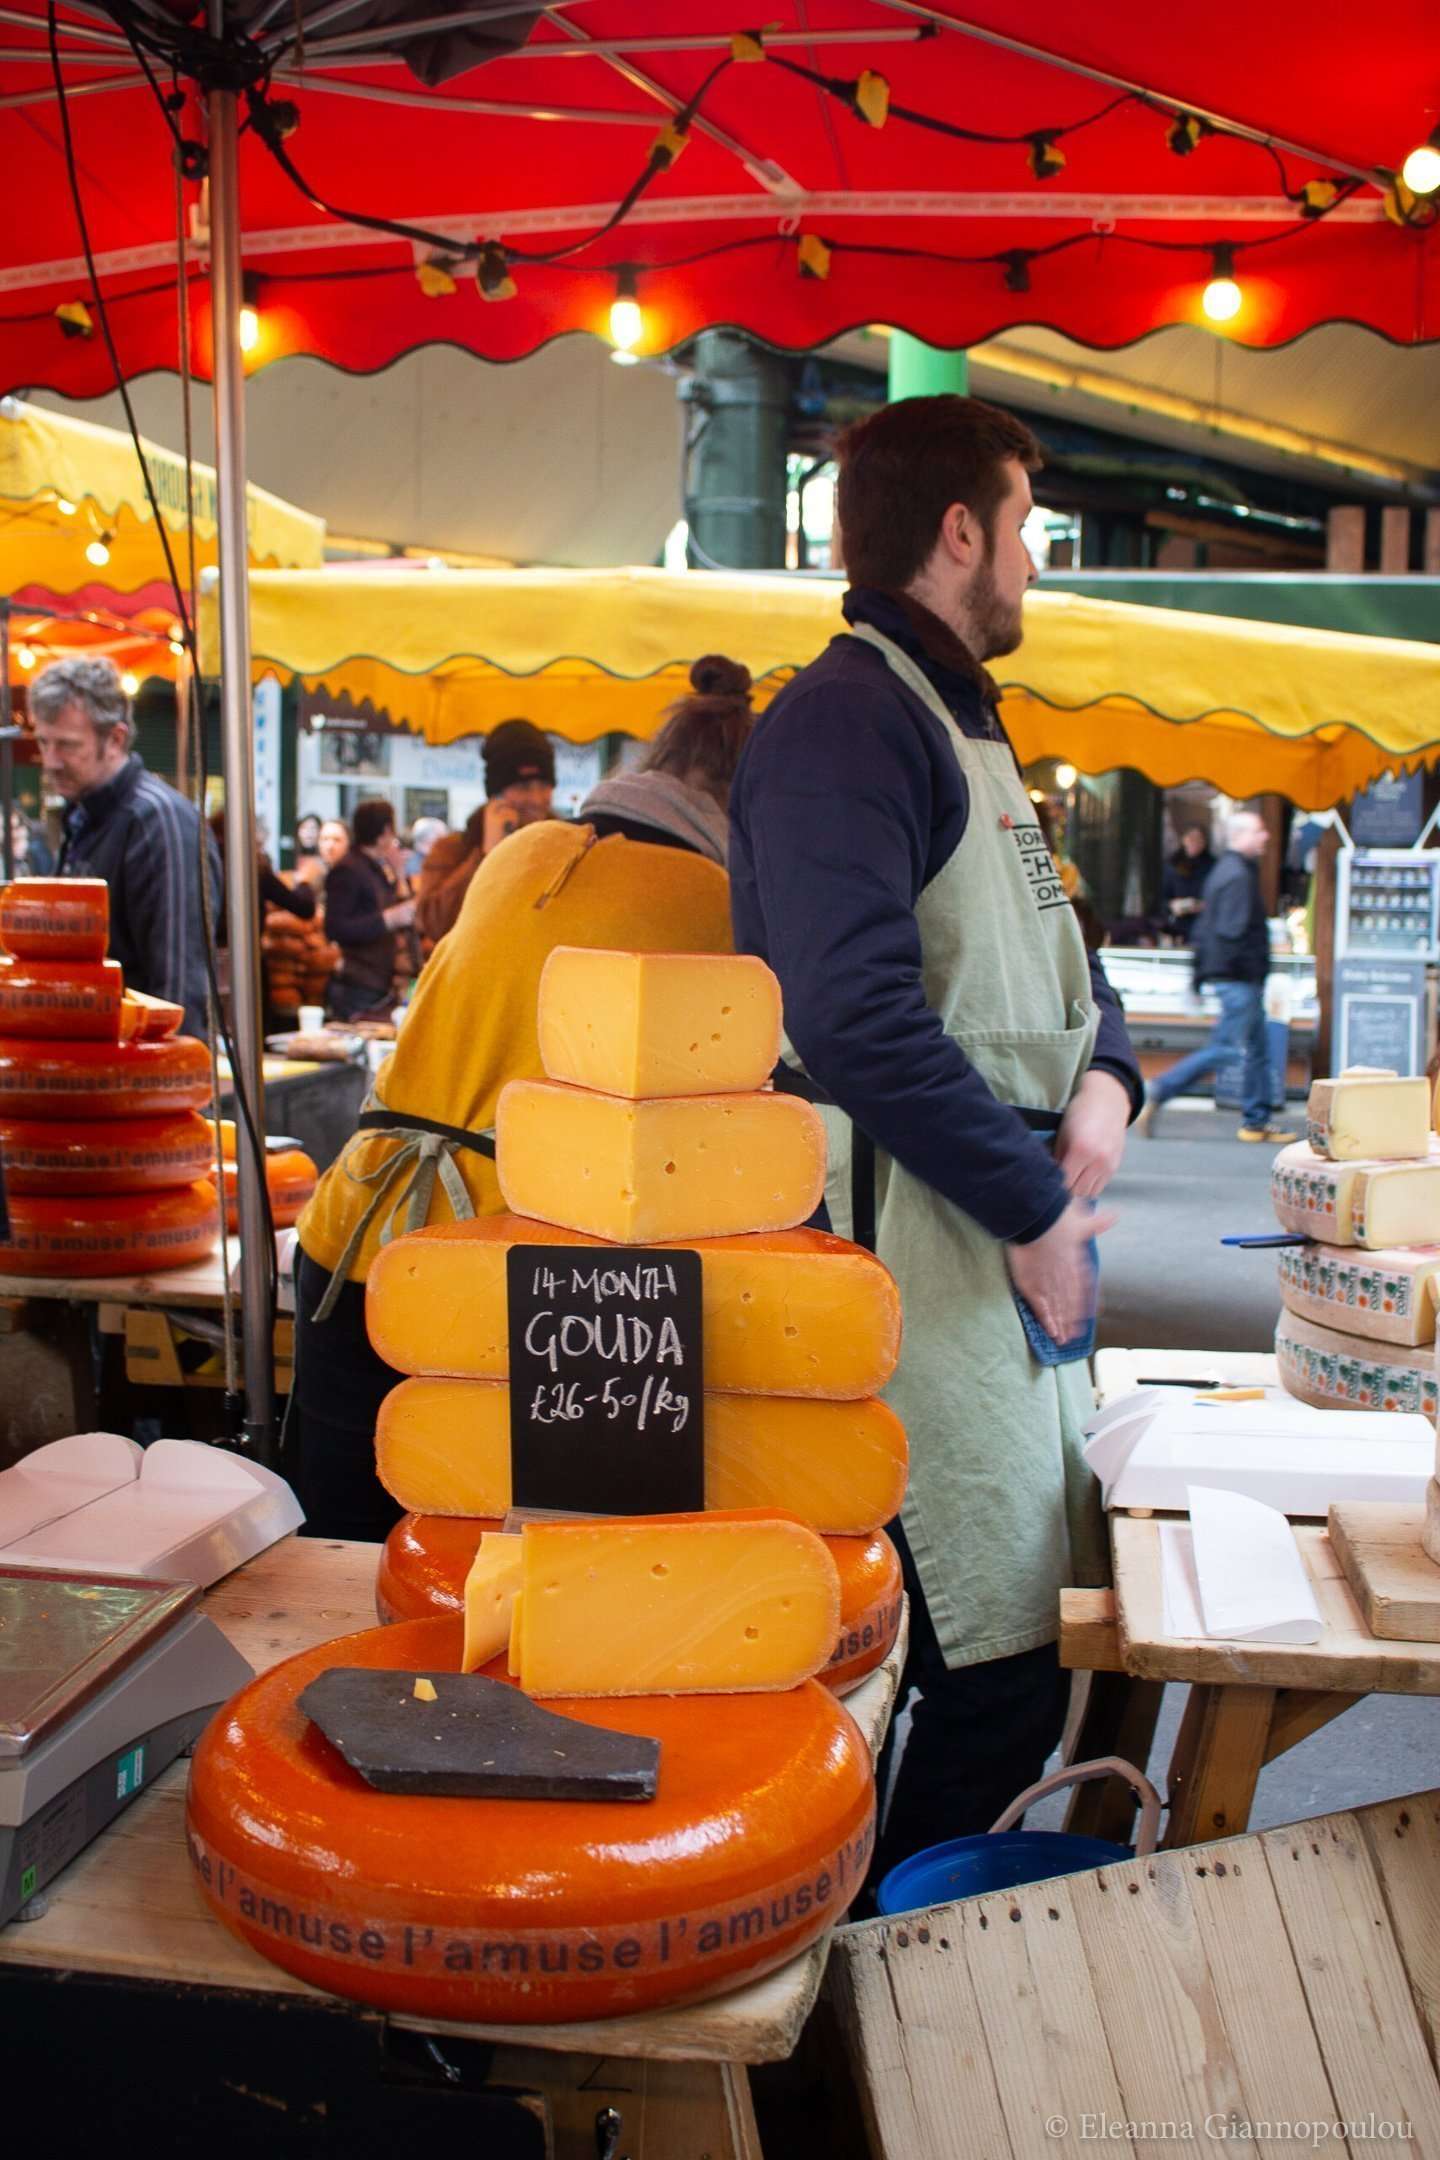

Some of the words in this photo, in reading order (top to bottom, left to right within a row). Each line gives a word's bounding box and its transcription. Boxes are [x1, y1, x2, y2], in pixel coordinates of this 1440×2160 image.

[532, 1266, 567, 1299] 14
[571, 1263, 677, 1304] MONTH
[524, 1311, 686, 1373] GOUDA
[218, 1859, 386, 1961] l'amuse
[403, 1926, 642, 1973] l'amuse
[659, 1869, 832, 1962] l'amuse
